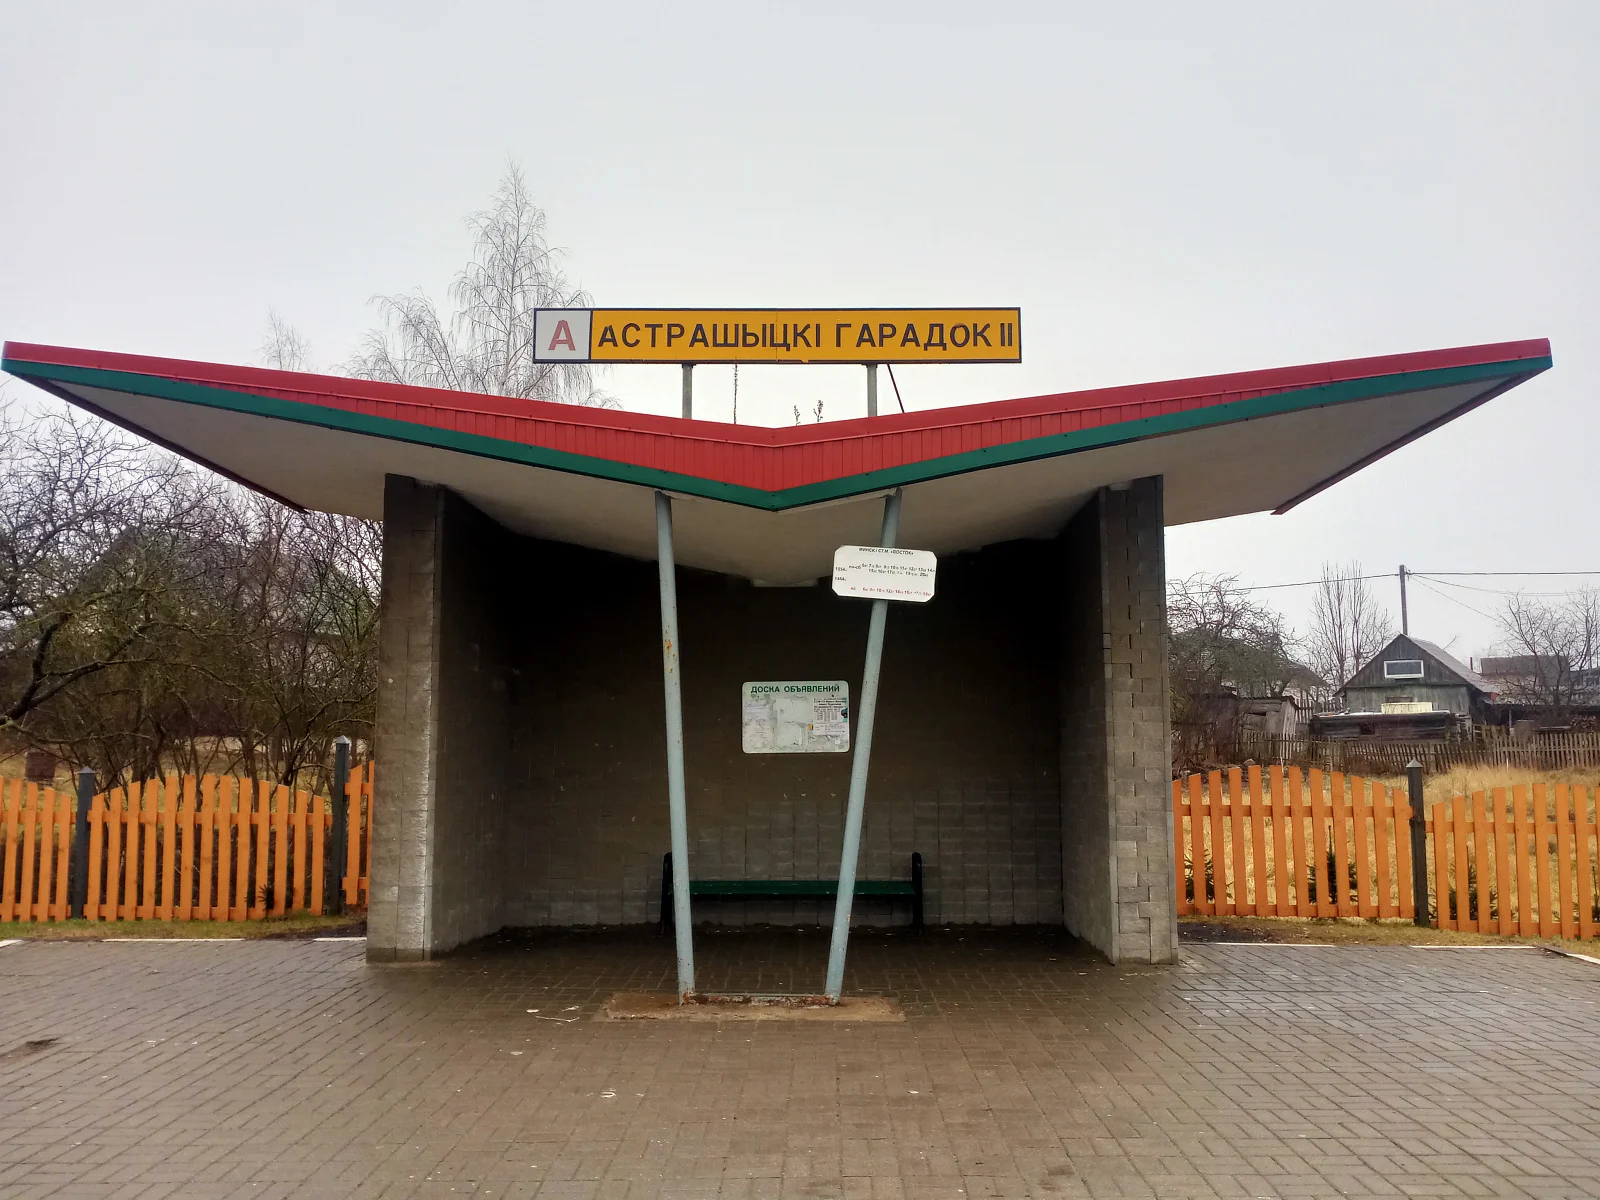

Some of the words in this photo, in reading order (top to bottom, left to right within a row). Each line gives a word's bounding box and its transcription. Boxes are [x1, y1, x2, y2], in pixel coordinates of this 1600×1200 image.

[597, 322, 821, 352] АСТРАШЫЦКІ
[835, 323, 993, 352] ГАРАДОК
[750, 685, 780, 694] ДОСКА
[783, 684, 840, 693] ОБЪЯВЛЕНИЙ
